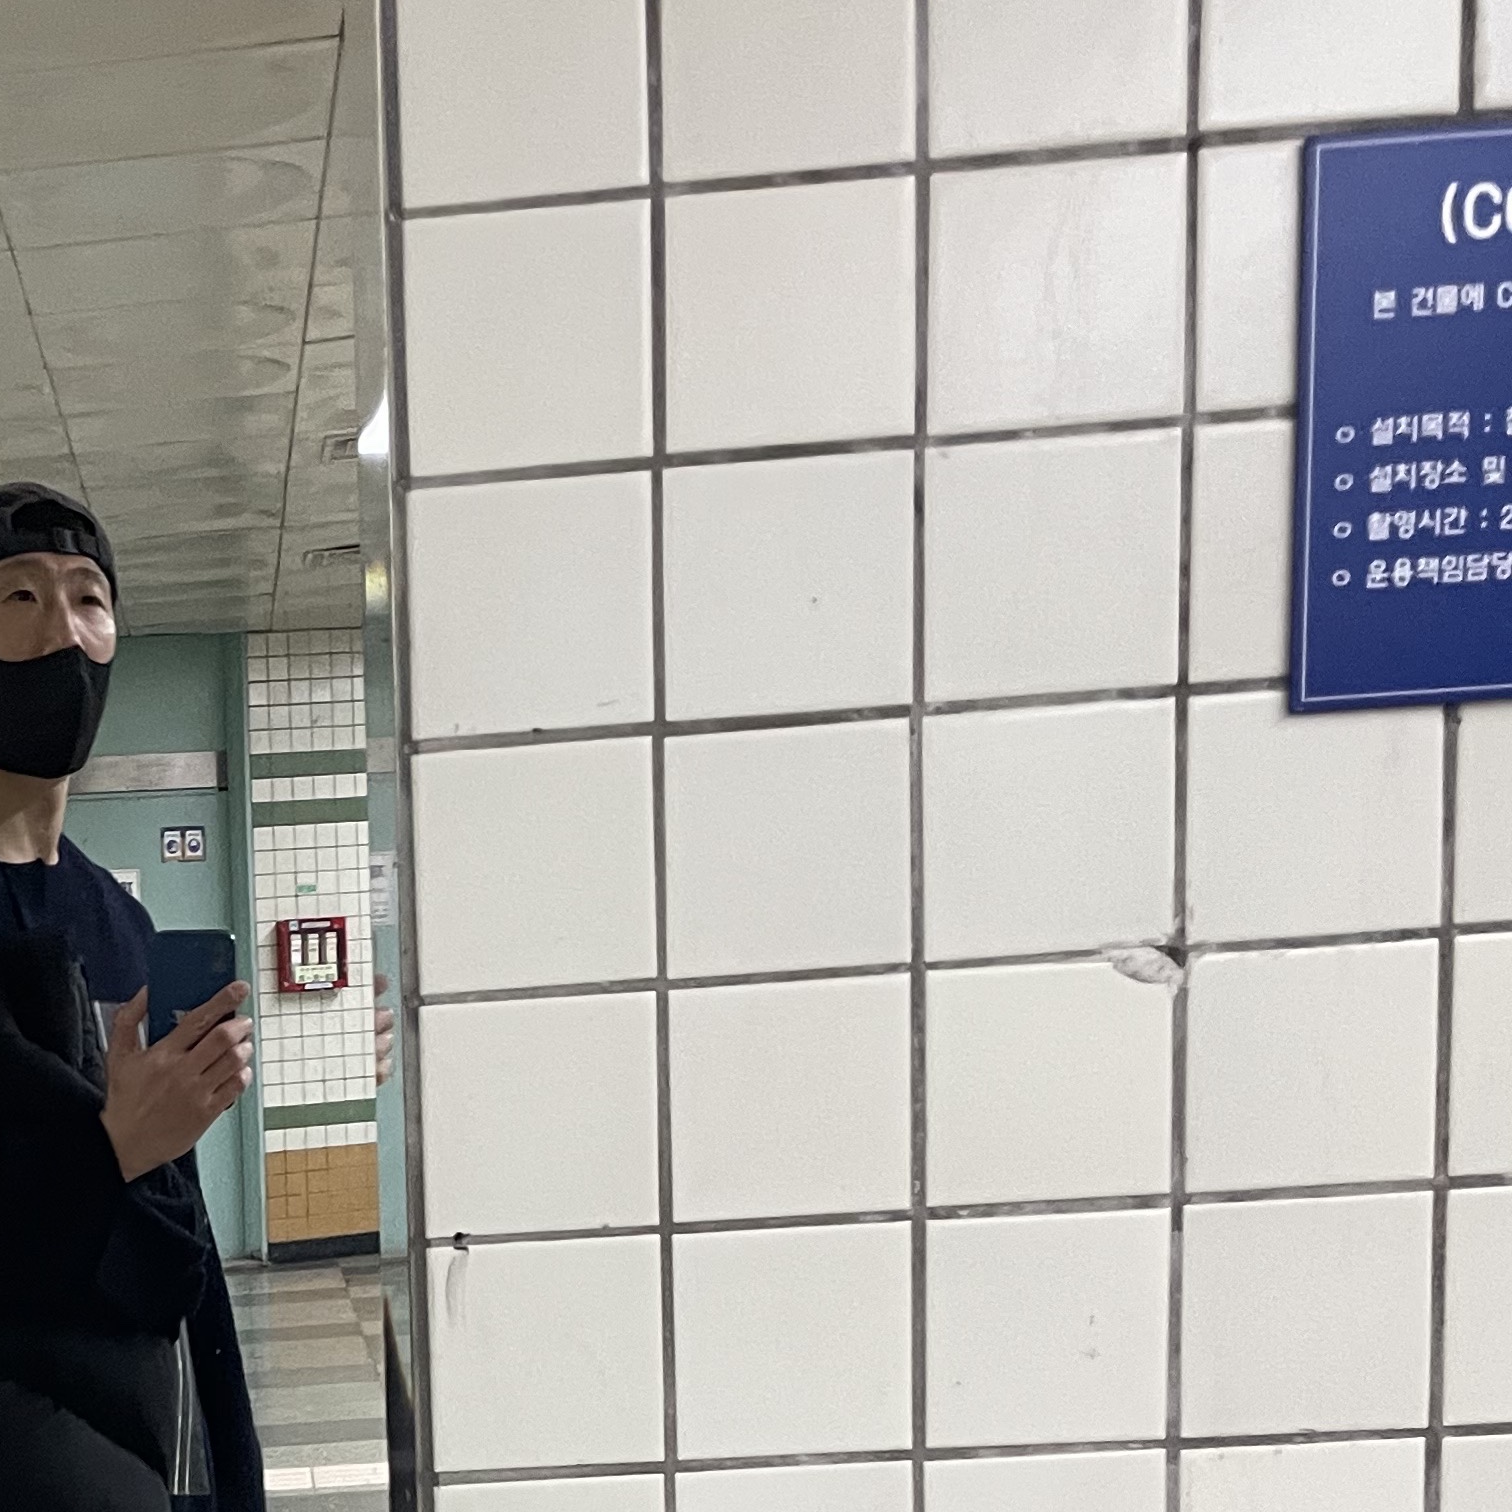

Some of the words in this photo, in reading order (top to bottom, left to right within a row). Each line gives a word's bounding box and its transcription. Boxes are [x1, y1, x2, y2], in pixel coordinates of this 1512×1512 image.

[1441, 181, 1512, 244] (C
[1371, 409, 1470, 446] 설치목적
[1369, 458, 1467, 493] 설치장소
[1483, 455, 1507, 486] 및
